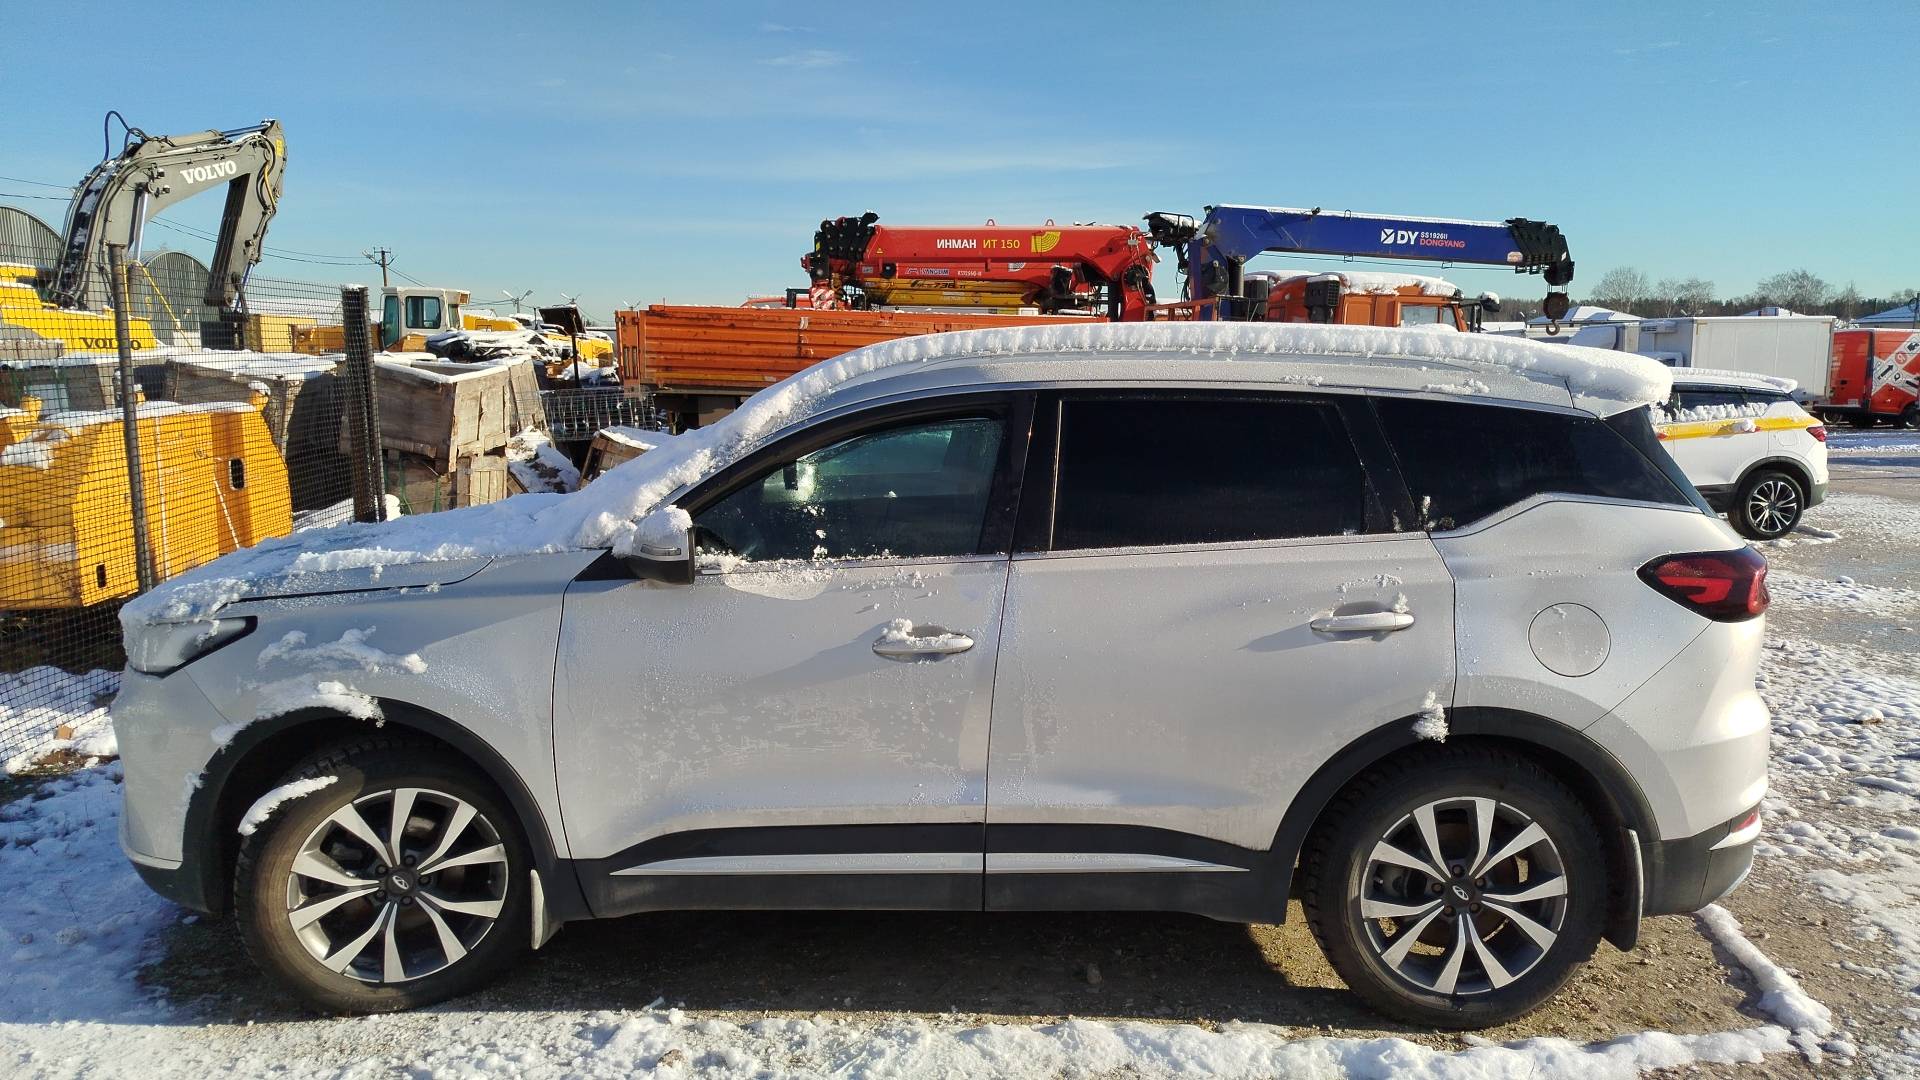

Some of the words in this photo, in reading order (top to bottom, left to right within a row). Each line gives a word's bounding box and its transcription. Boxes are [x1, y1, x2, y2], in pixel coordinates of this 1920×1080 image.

[179, 159, 237, 184] VOLVO
[936, 239, 977, 249] ИНМАН
[983, 239, 998, 249] ИТ
[1001, 239, 1020, 249] 150
[1396, 230, 1419, 245] DY
[1419, 238, 1465, 248] DONGYANG
[79, 336, 142, 351] VOLO
